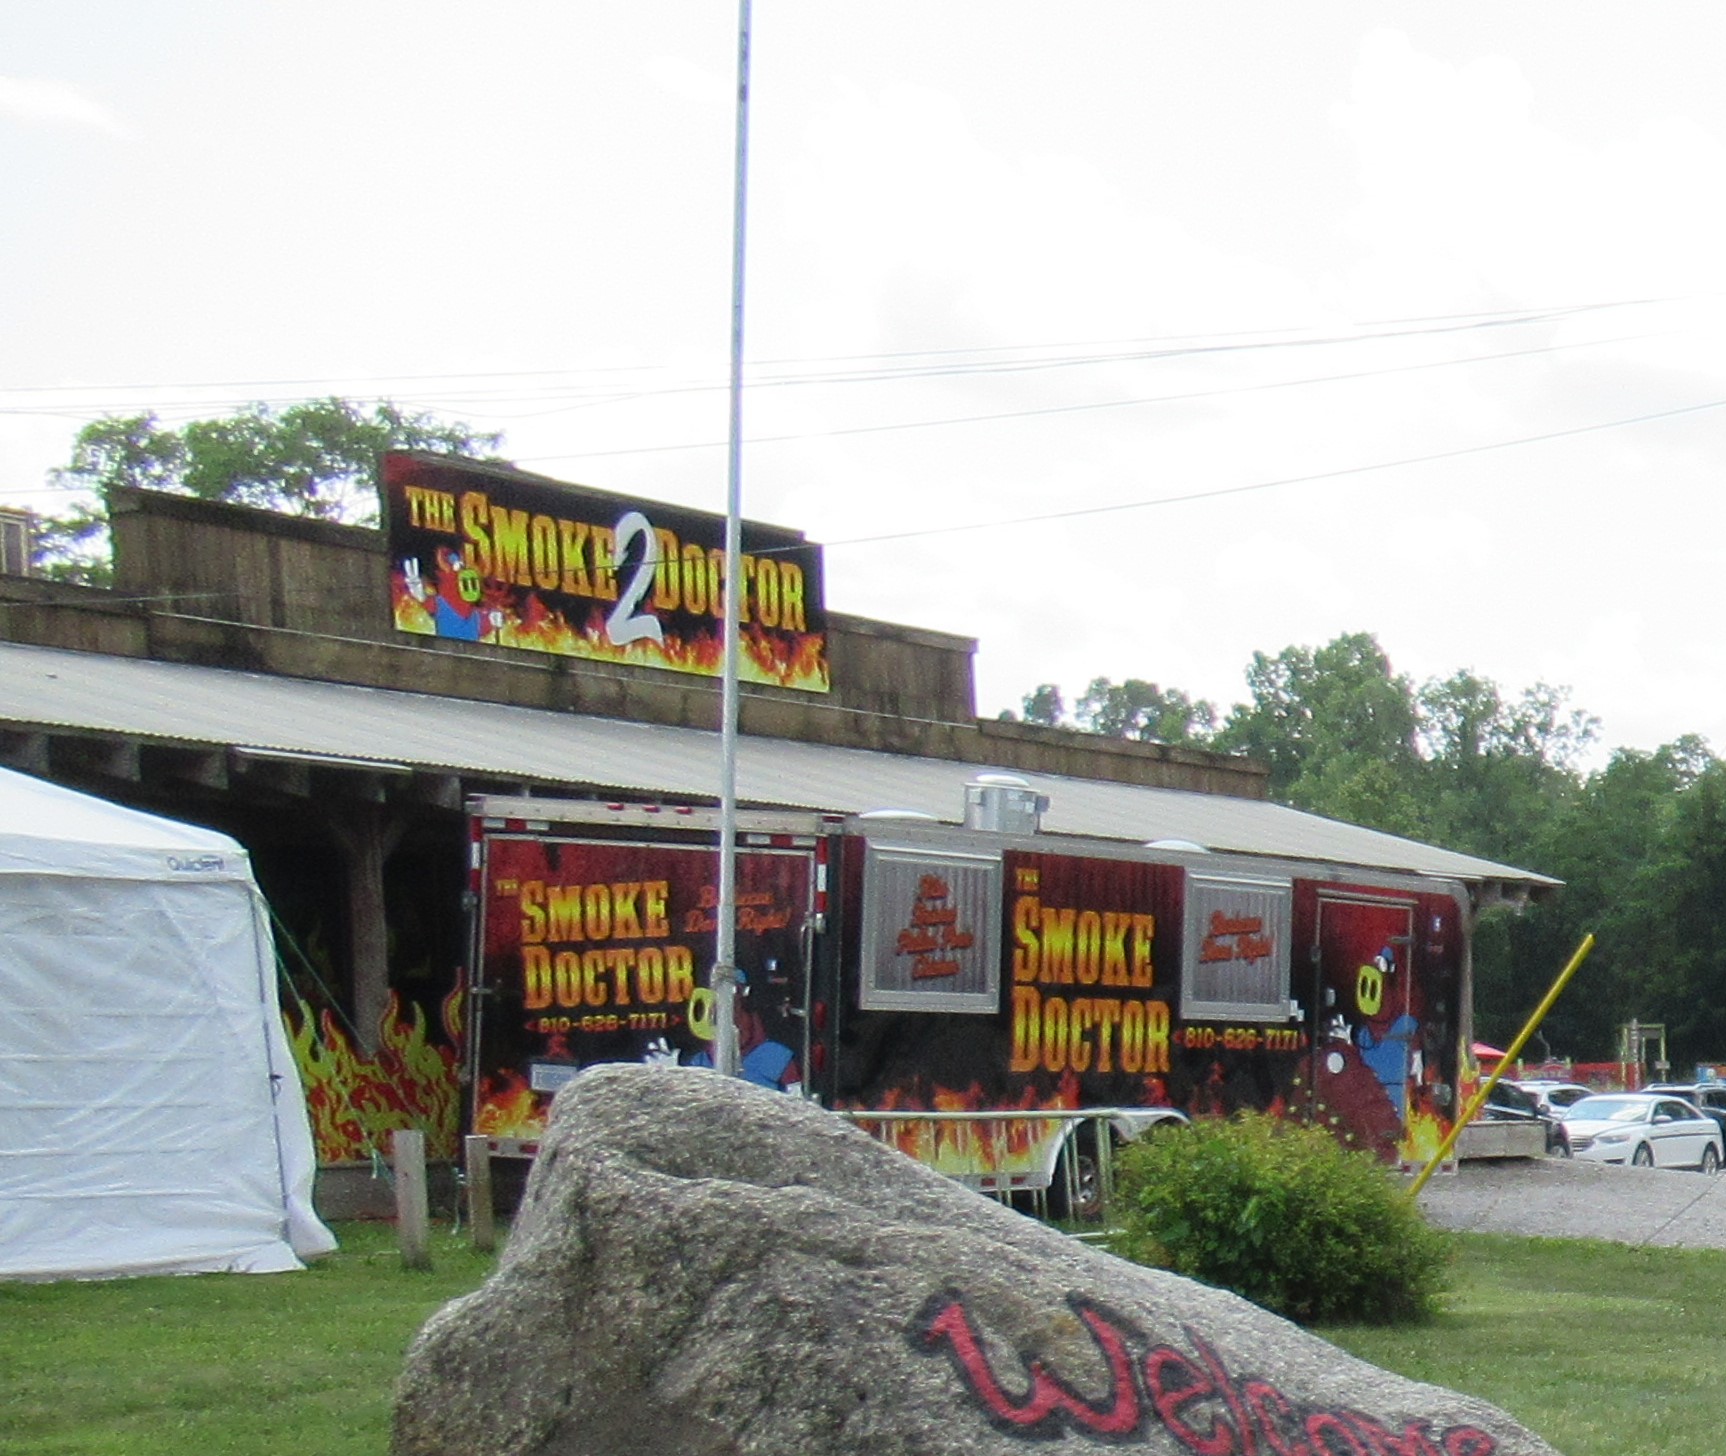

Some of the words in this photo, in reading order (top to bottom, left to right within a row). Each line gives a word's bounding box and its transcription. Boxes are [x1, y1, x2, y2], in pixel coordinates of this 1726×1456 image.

[404, 485, 456, 533] THE
[459, 491, 618, 600] SMOKE
[606, 511, 664, 647] 2
[652, 527, 808, 633] DOCTOR
[520, 880, 671, 943] SMOKE
[1013, 896, 1155, 987] SMOKE
[522, 945, 695, 1009] DOCTOR
[1010, 985, 1171, 1073] DOCTOR
